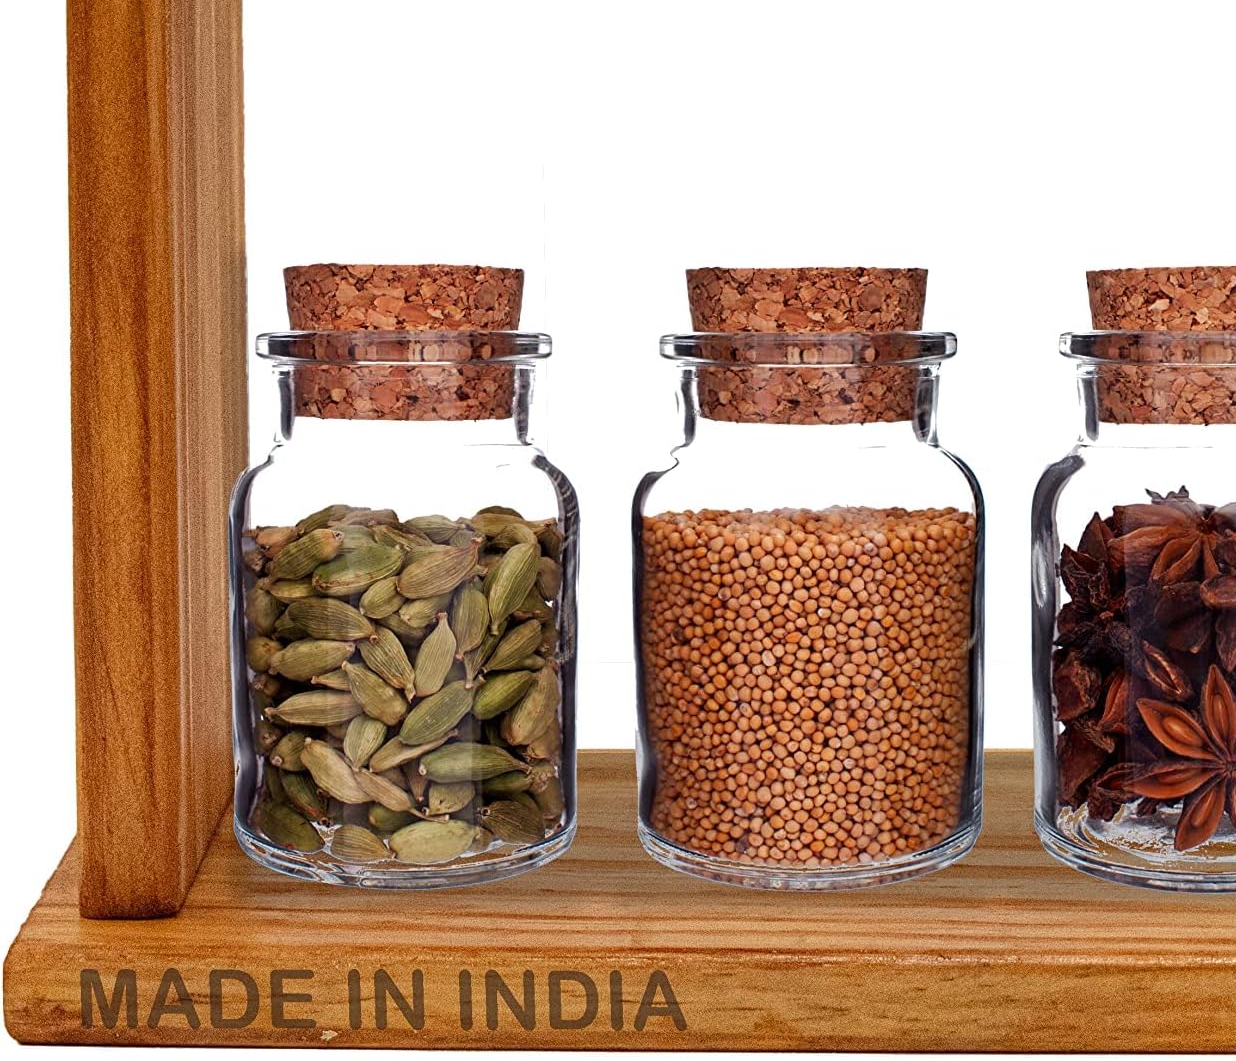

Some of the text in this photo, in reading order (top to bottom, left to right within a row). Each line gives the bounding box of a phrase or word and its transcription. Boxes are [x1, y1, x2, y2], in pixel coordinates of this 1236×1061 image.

[80, 969, 689, 1030] MADE IN INDIA
